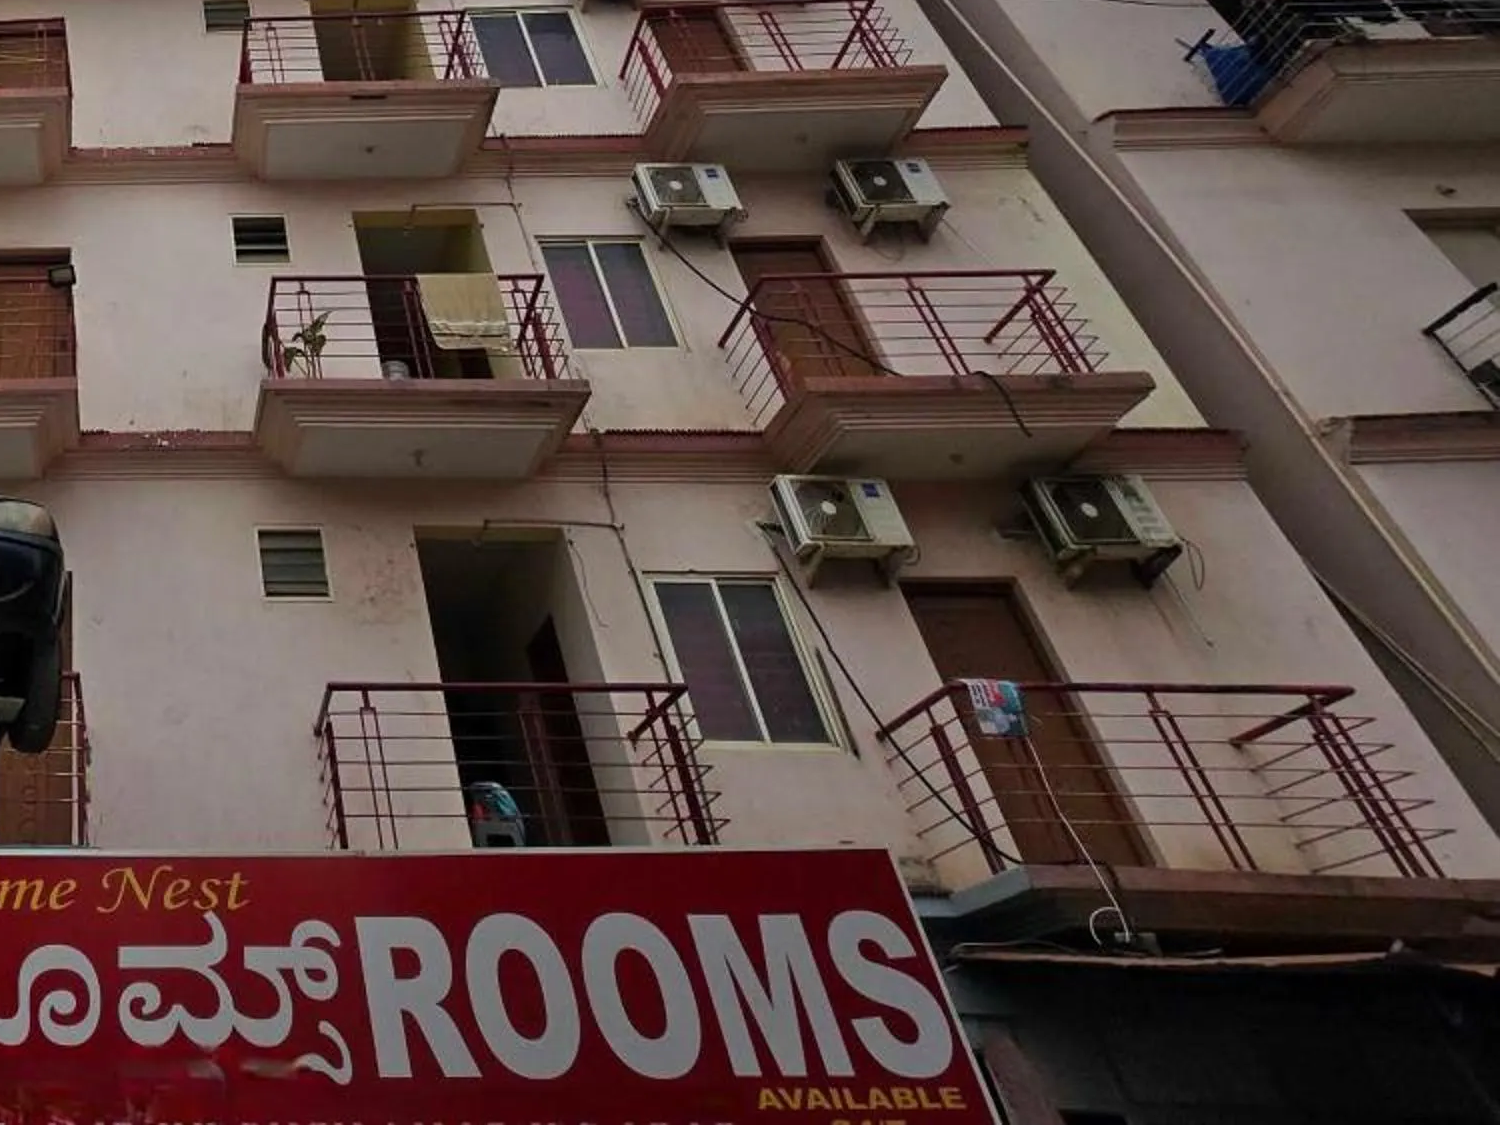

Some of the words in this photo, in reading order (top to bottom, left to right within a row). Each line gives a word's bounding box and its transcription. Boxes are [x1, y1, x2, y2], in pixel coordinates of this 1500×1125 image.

[97, 864, 249, 913] Nest
[354, 910, 954, 1080] ROOMS
[758, 1085, 967, 1111] AVAILABLE
